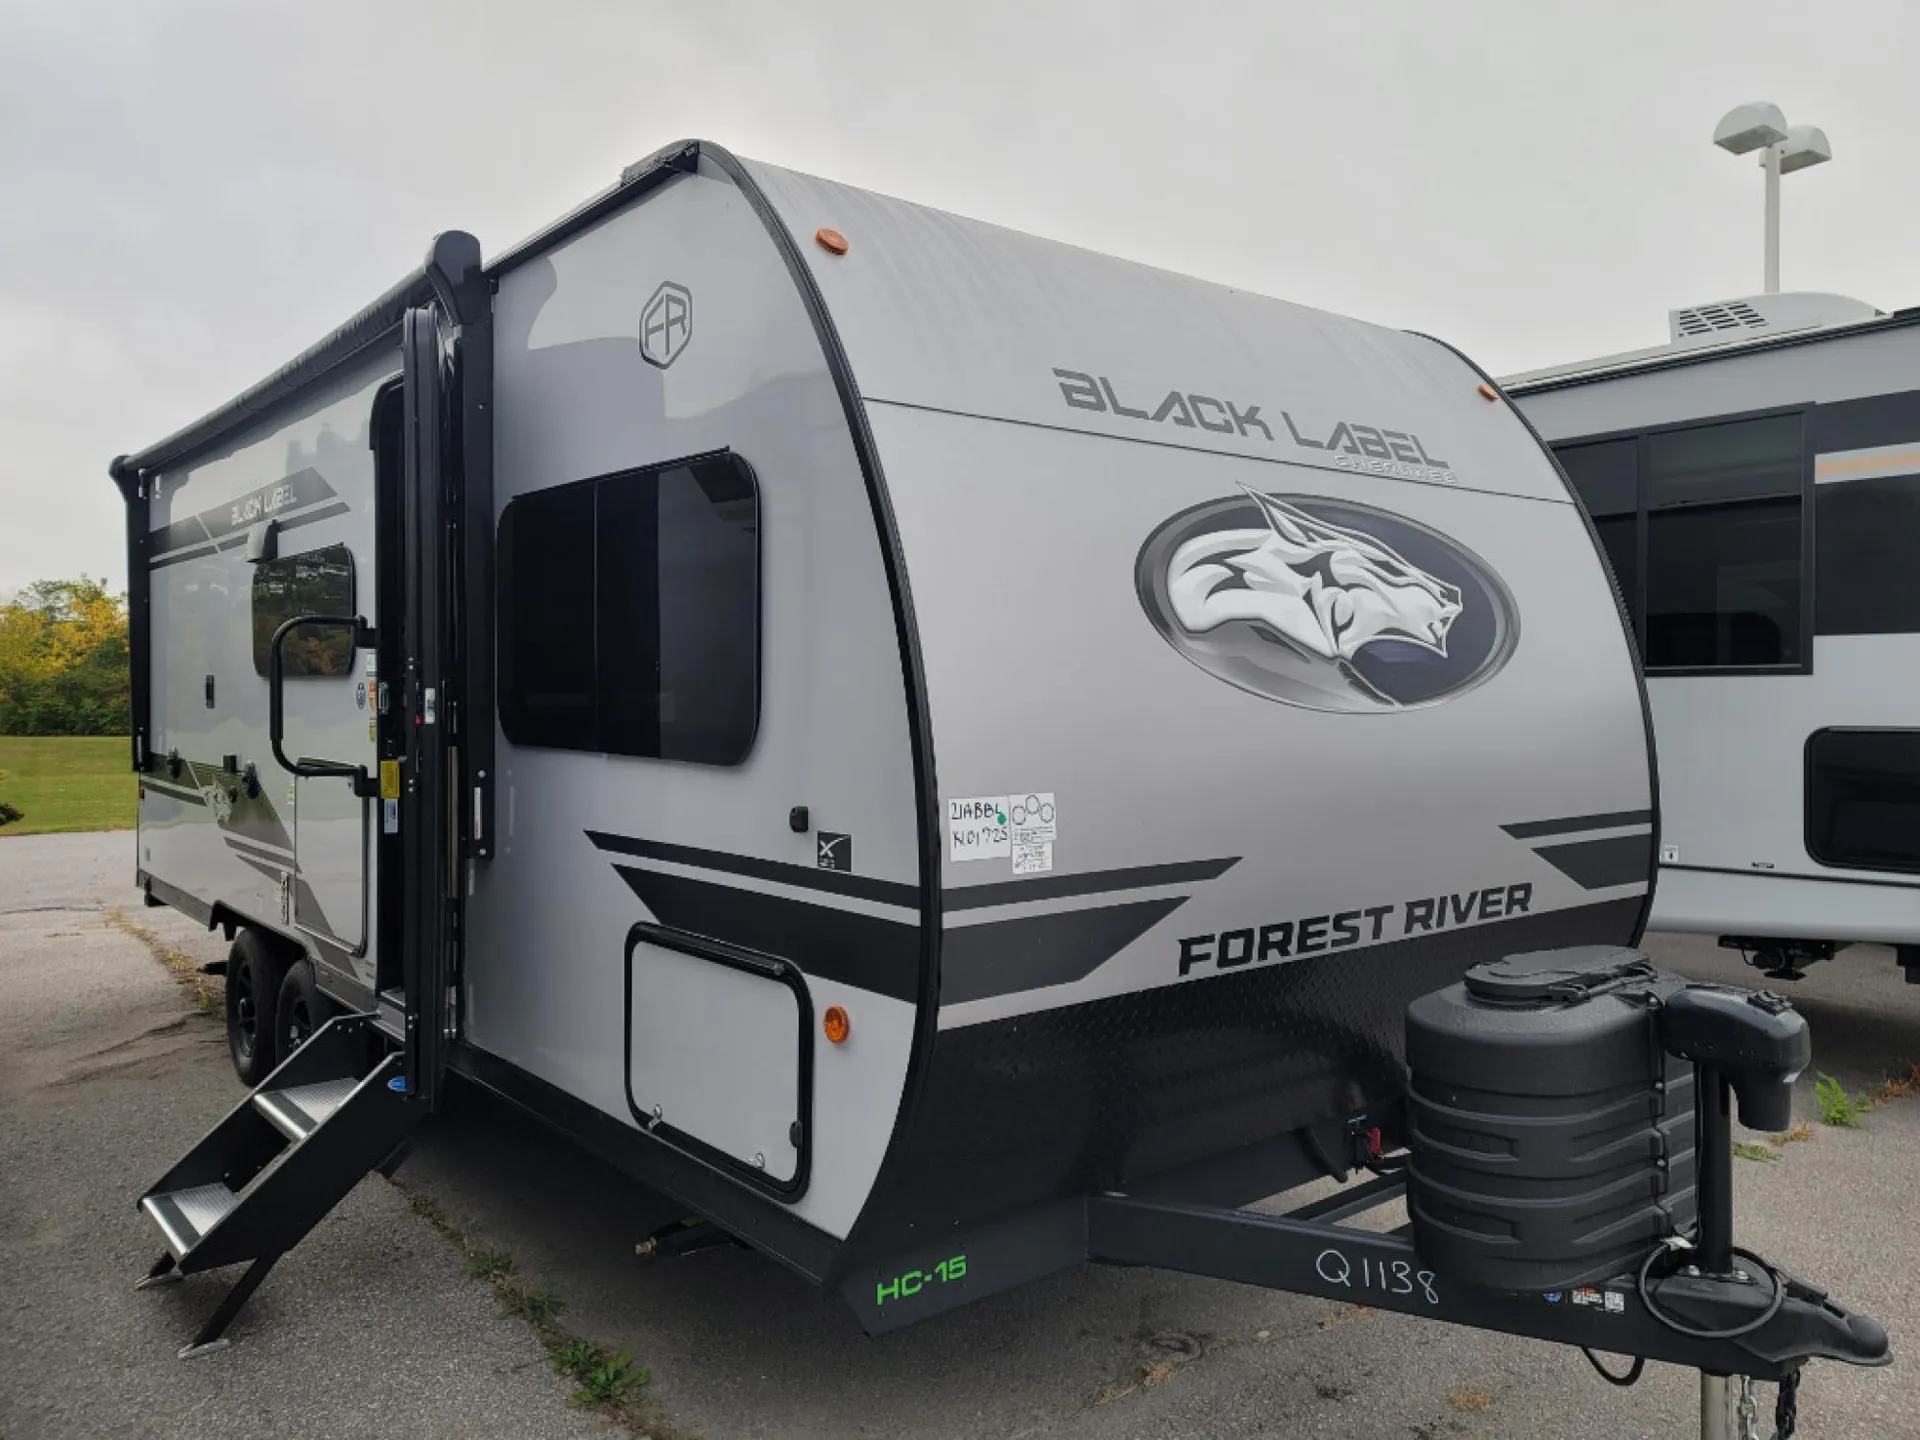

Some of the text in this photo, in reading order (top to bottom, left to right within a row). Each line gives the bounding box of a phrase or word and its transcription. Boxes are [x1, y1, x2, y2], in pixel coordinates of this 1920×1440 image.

[1052, 367, 1450, 469] BLACK LABEL
[1177, 882, 1533, 977] FOREST RIVER
[876, 1255, 967, 1306] HC-15
[1315, 1250, 1439, 1304] Q1138
